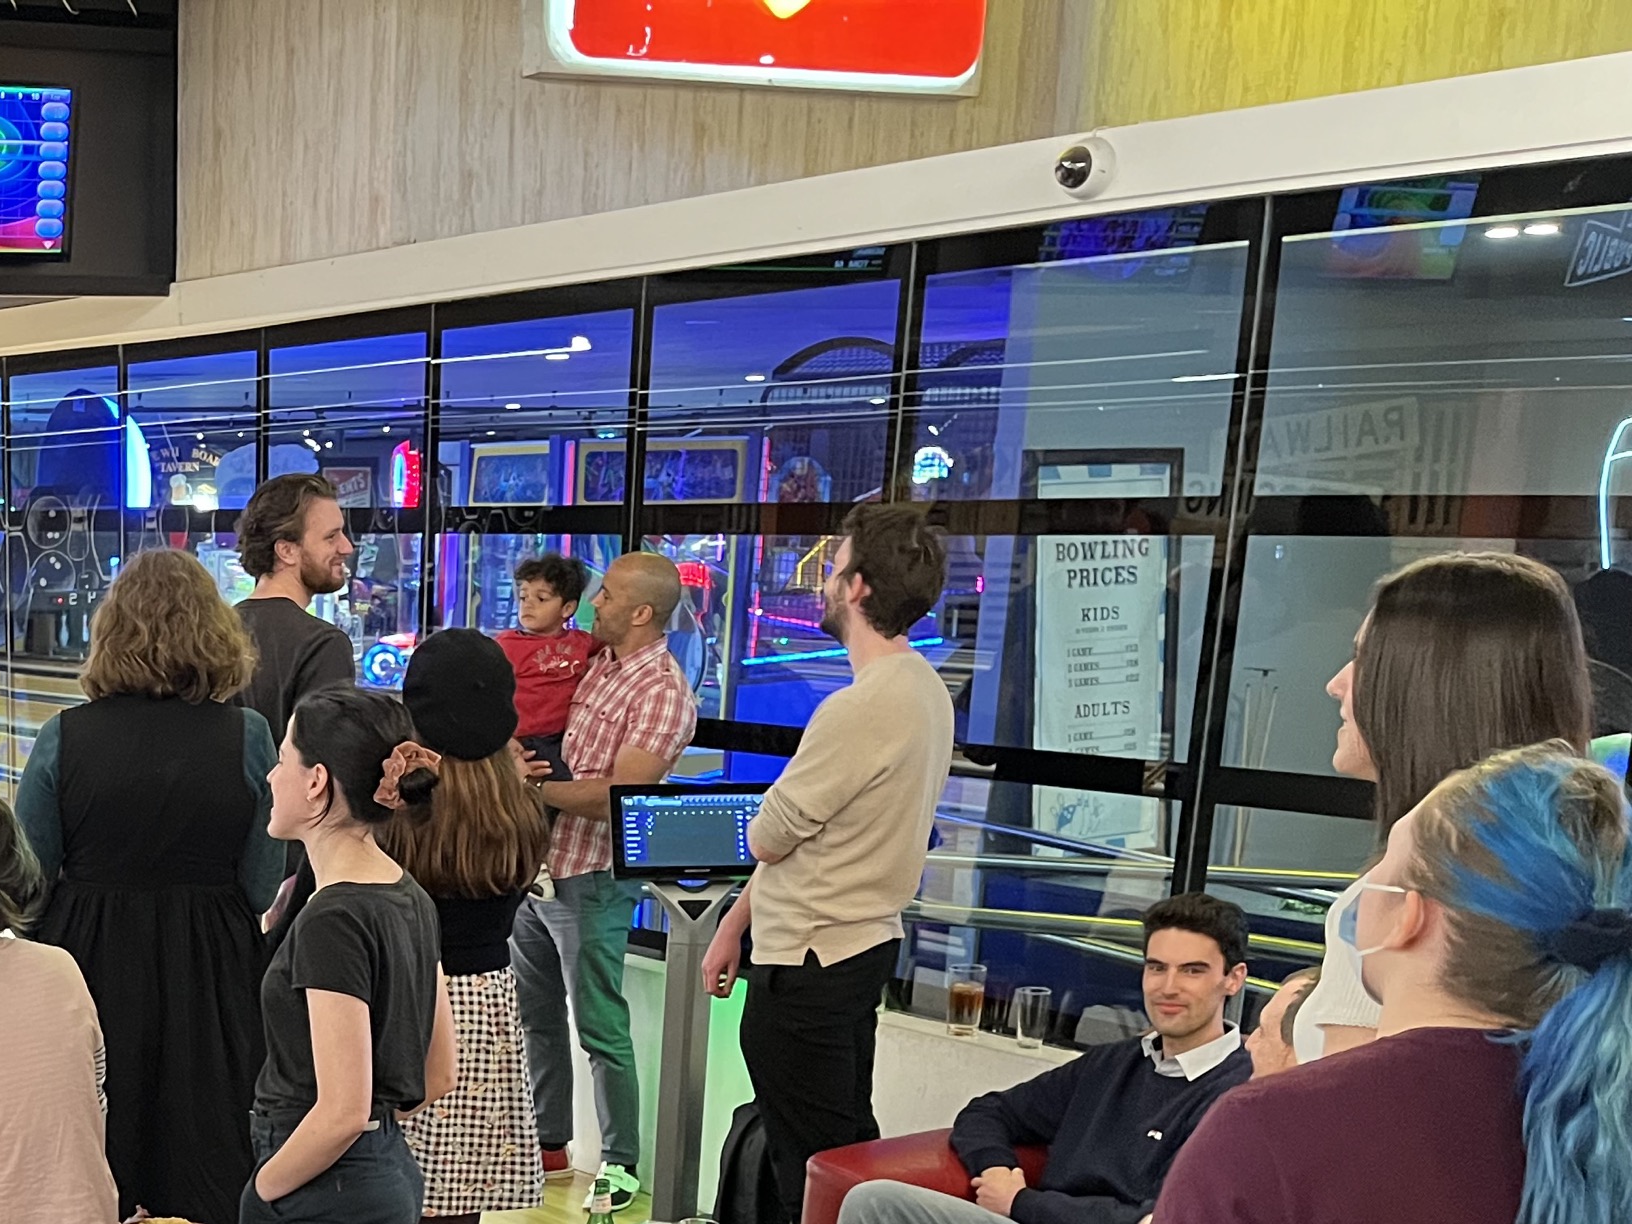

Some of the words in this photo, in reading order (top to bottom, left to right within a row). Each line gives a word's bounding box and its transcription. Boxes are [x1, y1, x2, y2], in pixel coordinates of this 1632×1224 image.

[0, 91, 6, 99] 8
[18, 92, 23, 100] 9
[31, 92, 40, 101] 10
[160, 462, 200, 473] TAVERN
[1055, 538, 1150, 562] BOWLING
[1066, 565, 1138, 589] PRICES
[1080, 606, 1121, 622] KIDS
[1074, 700, 1130, 719] ADULTS
